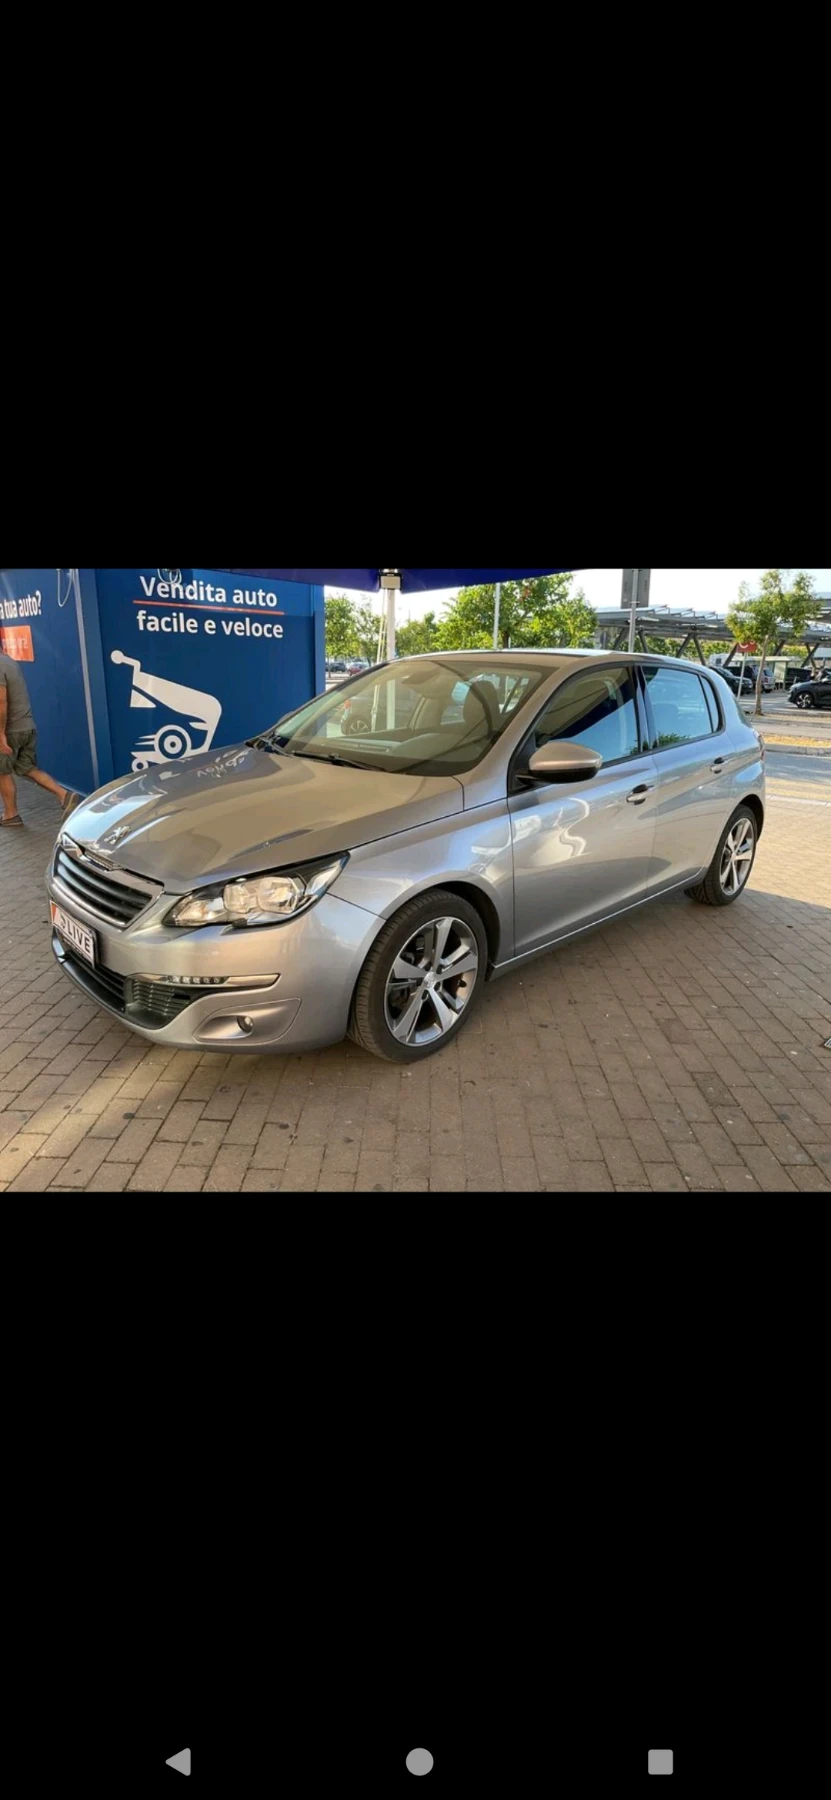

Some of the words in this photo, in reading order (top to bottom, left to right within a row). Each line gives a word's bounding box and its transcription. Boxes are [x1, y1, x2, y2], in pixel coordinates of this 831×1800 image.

[4, 598, 18, 620] tua
[18, 589, 42, 618] auto?
[139, 575, 226, 603] Vendita
[232, 587, 278, 608] auto
[136, 609, 198, 634] facile
[204, 618, 217, 635] e
[221, 617, 284, 639] veloce
